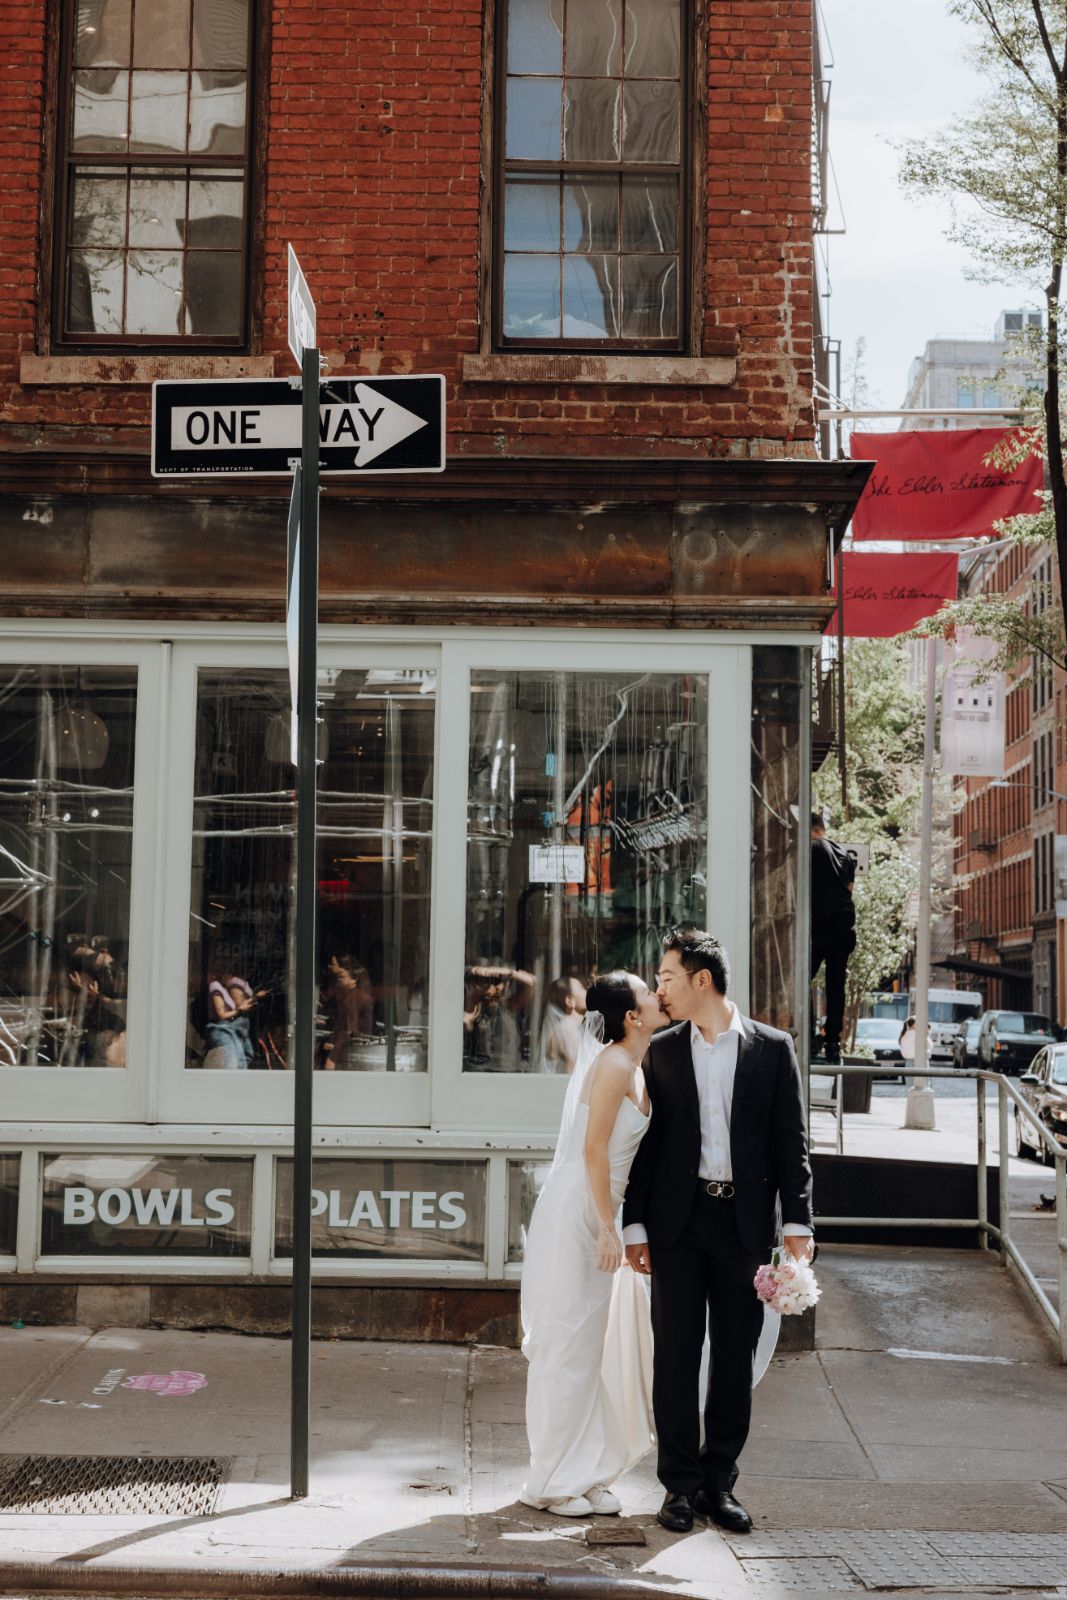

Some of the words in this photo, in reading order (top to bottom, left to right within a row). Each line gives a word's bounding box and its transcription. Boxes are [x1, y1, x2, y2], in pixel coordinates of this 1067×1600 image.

[186, 410, 261, 445] ONE
[192, 465, 254, 473] TRANSPORTATION
[898, 475, 943, 496] Elder
[950, 473, 1030, 491] Statesman
[882, 586, 946, 600] Statesman
[63, 1186, 236, 1226] BOWLS
